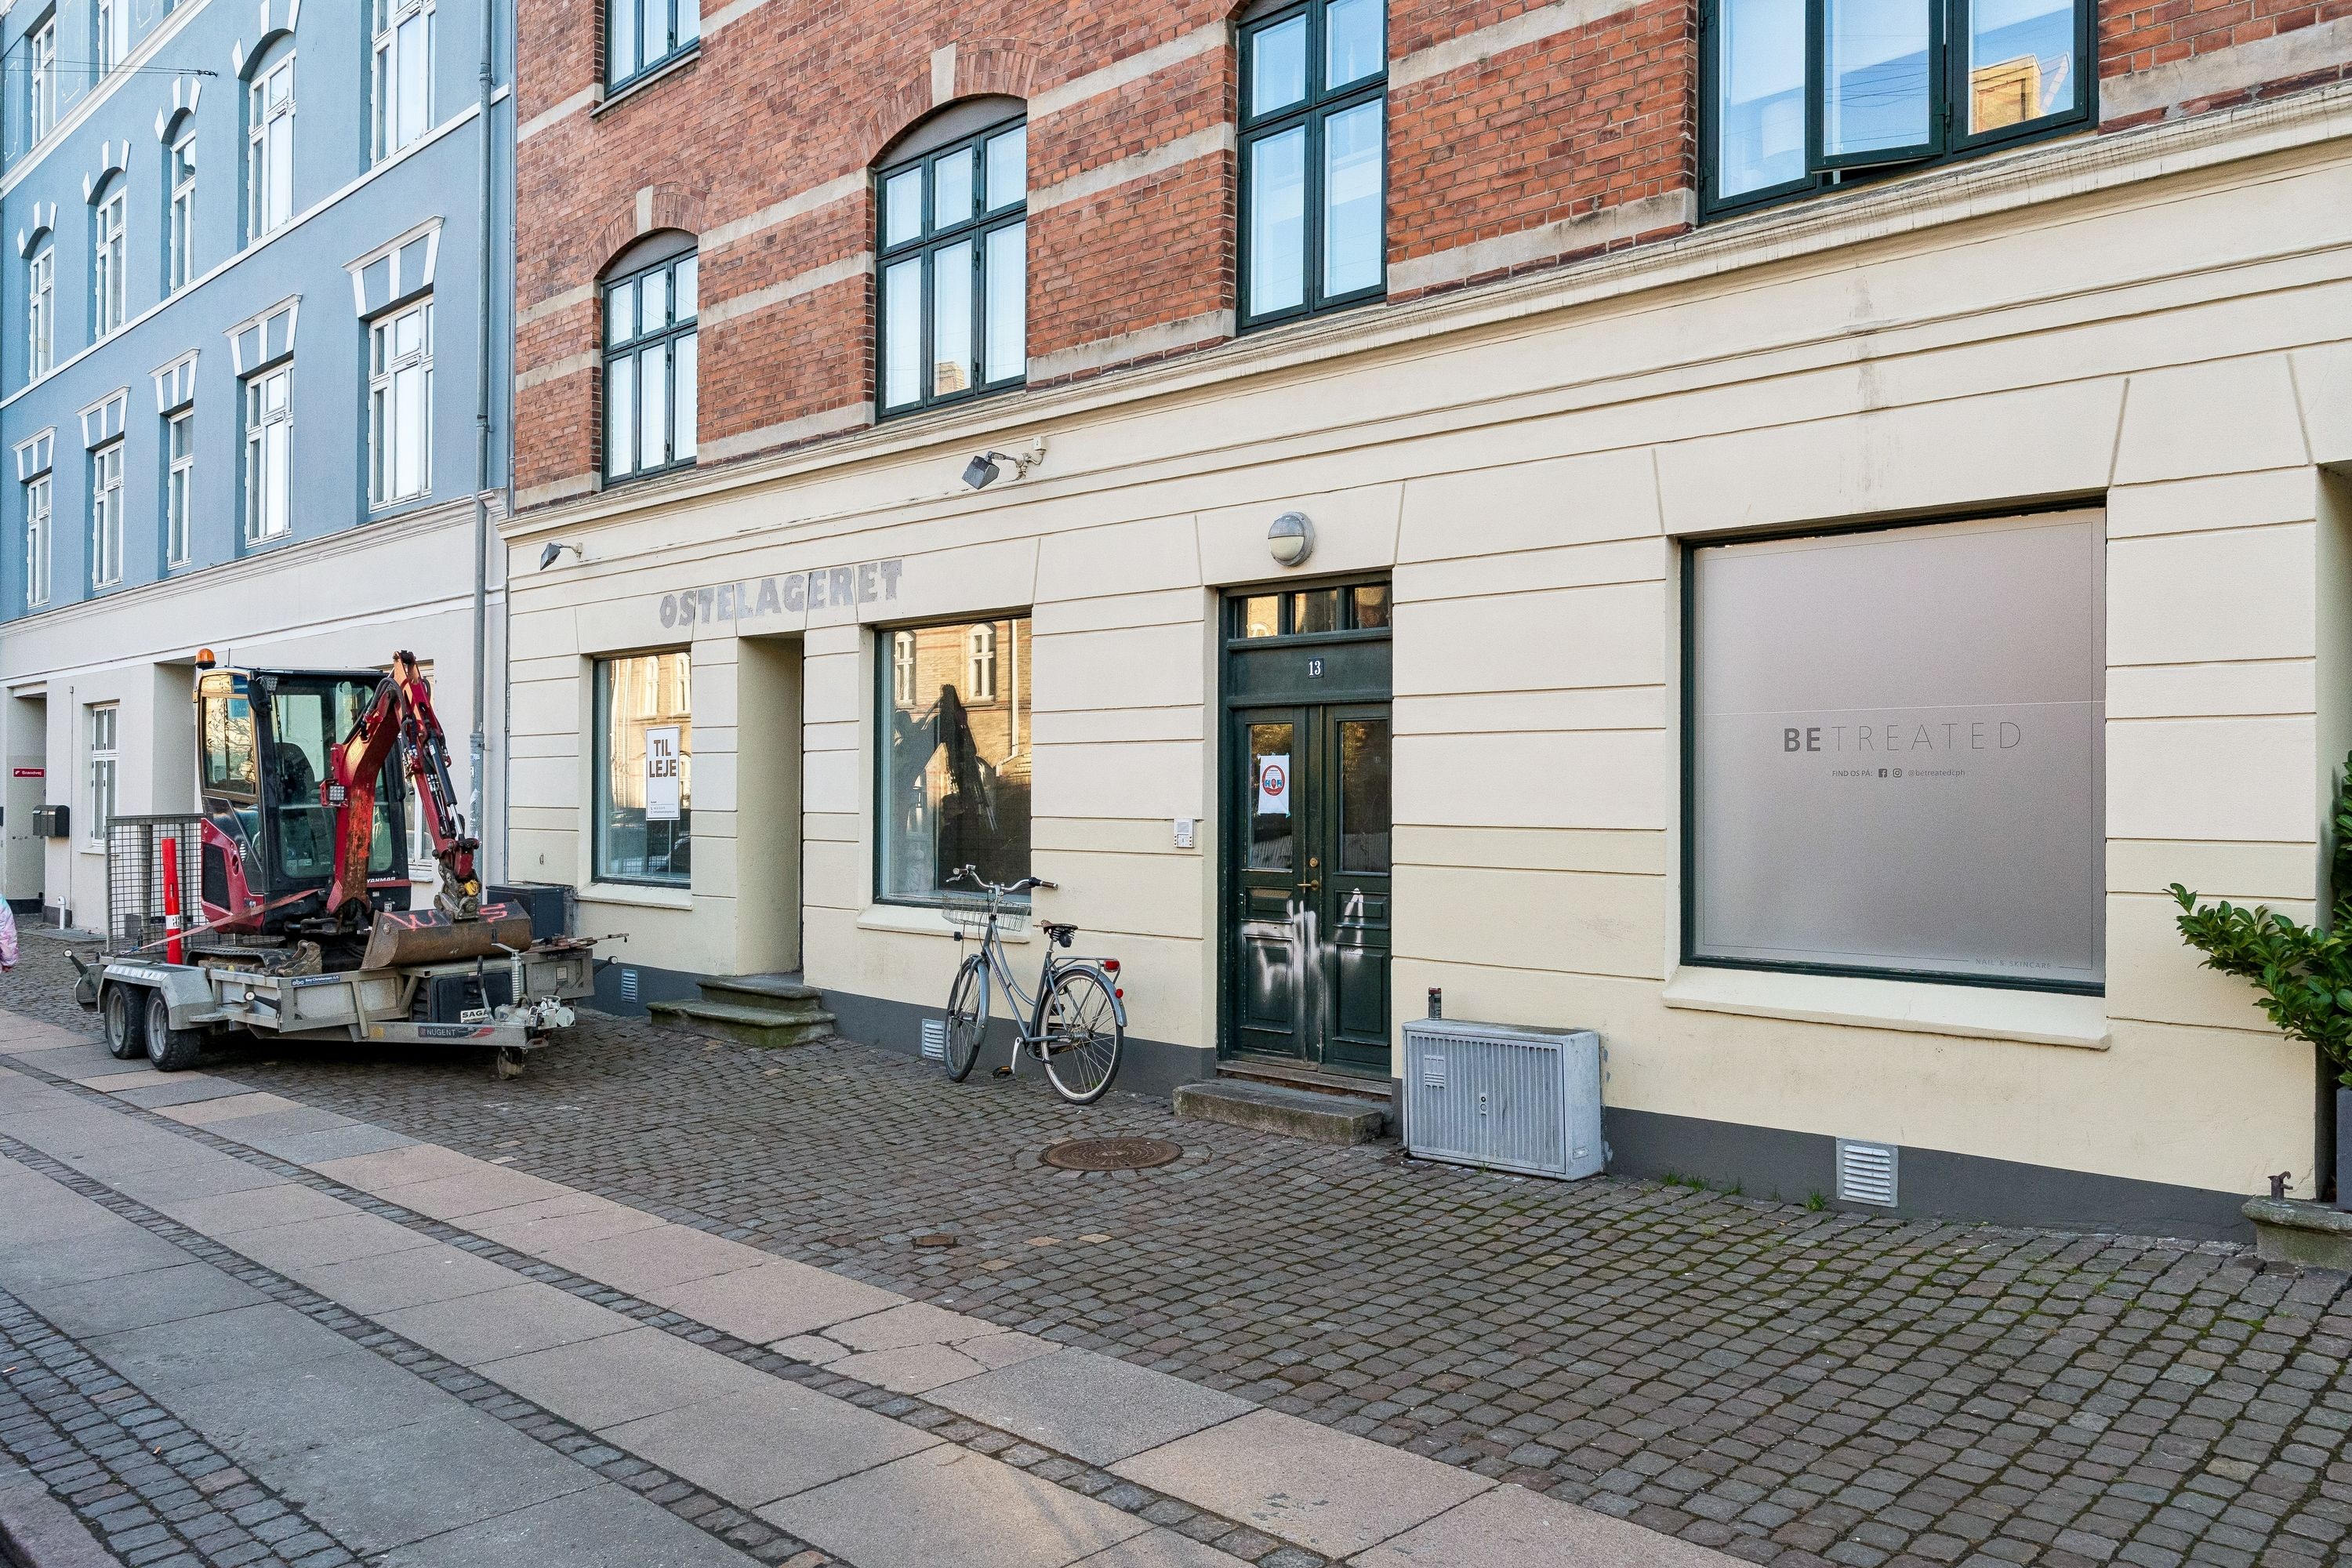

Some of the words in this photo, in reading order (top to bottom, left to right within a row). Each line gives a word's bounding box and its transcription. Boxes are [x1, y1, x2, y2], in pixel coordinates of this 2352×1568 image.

[659, 560, 902, 629] OSTELAGERET
[1308, 660, 1321, 675] 13
[653, 739, 672, 757] TIL
[649, 759, 677, 778] LEJE
[1907, 768, 1965, 778] @betreatedcph
[2009, 960, 2052, 969] SKINCARE
